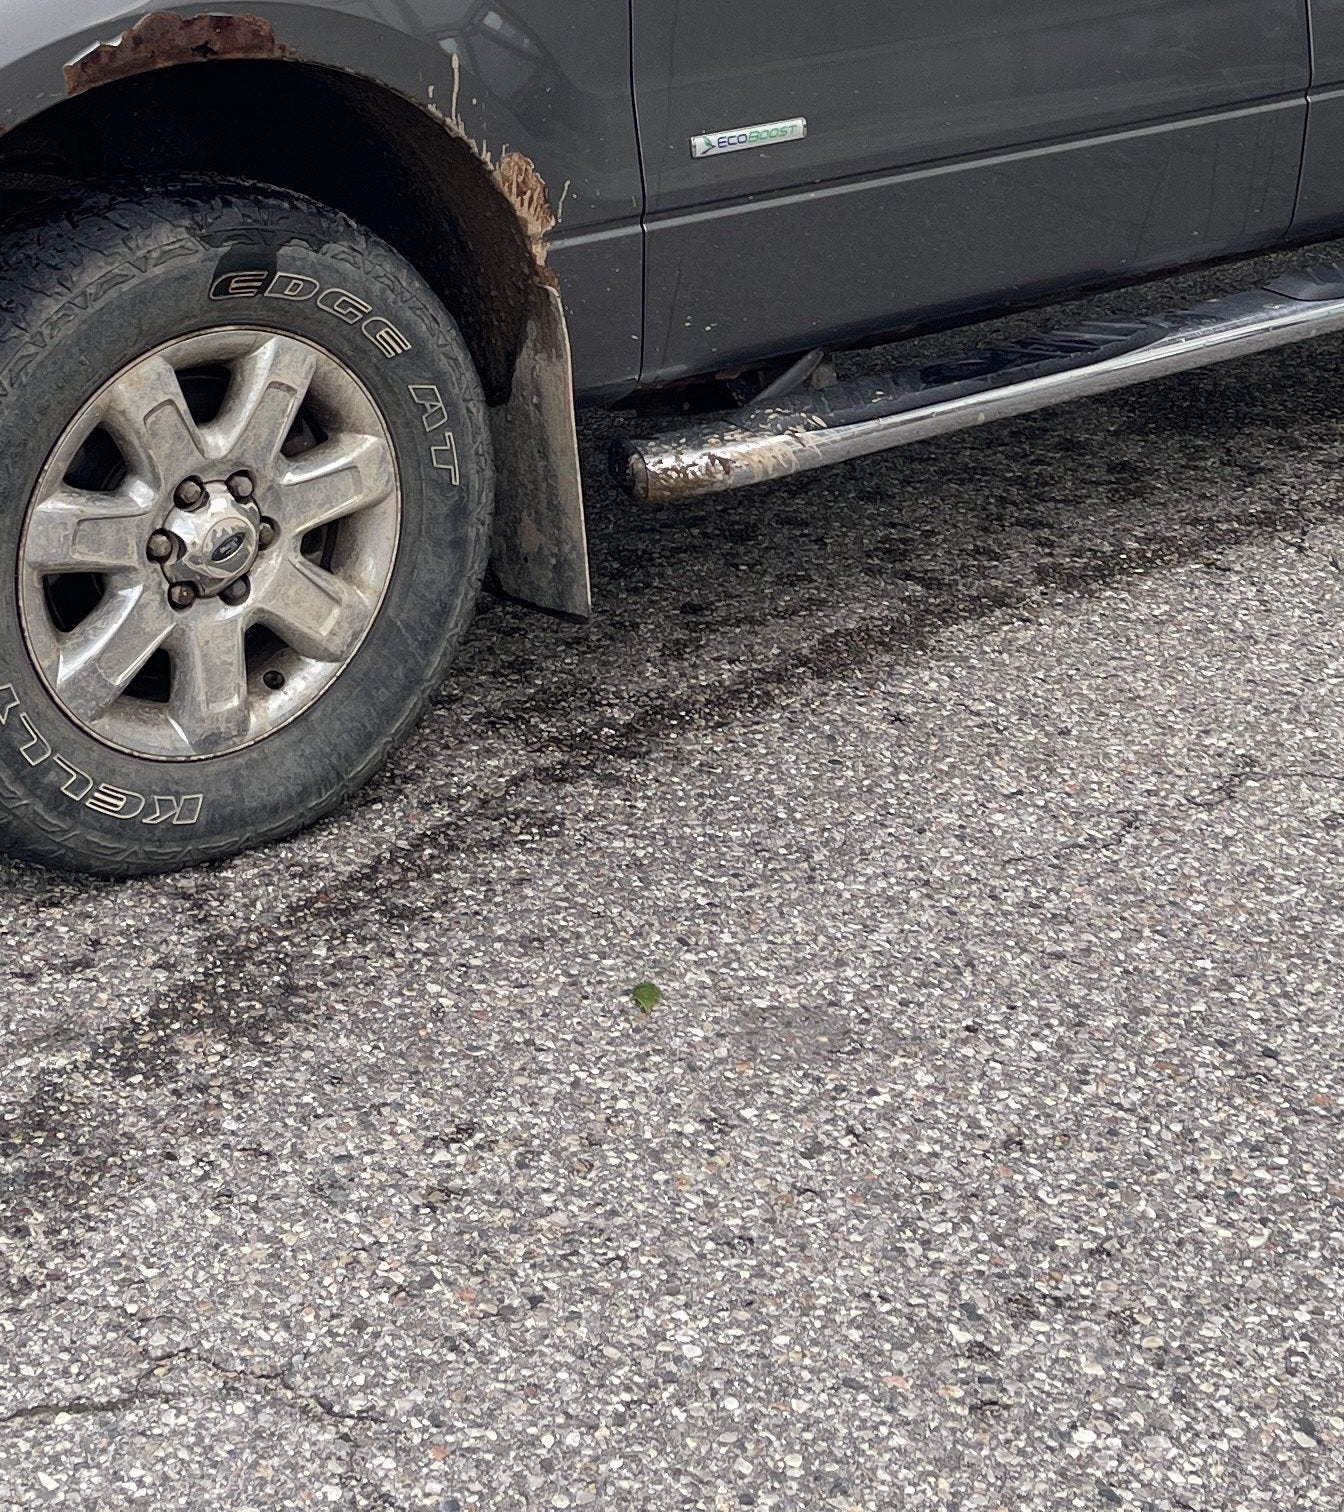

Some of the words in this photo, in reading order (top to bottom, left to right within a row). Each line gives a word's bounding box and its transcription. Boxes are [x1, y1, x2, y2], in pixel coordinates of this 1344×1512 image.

[716, 124, 798, 149] ECOBOOST
[209, 271, 413, 360] EDGE
[408, 383, 461, 487] AT
